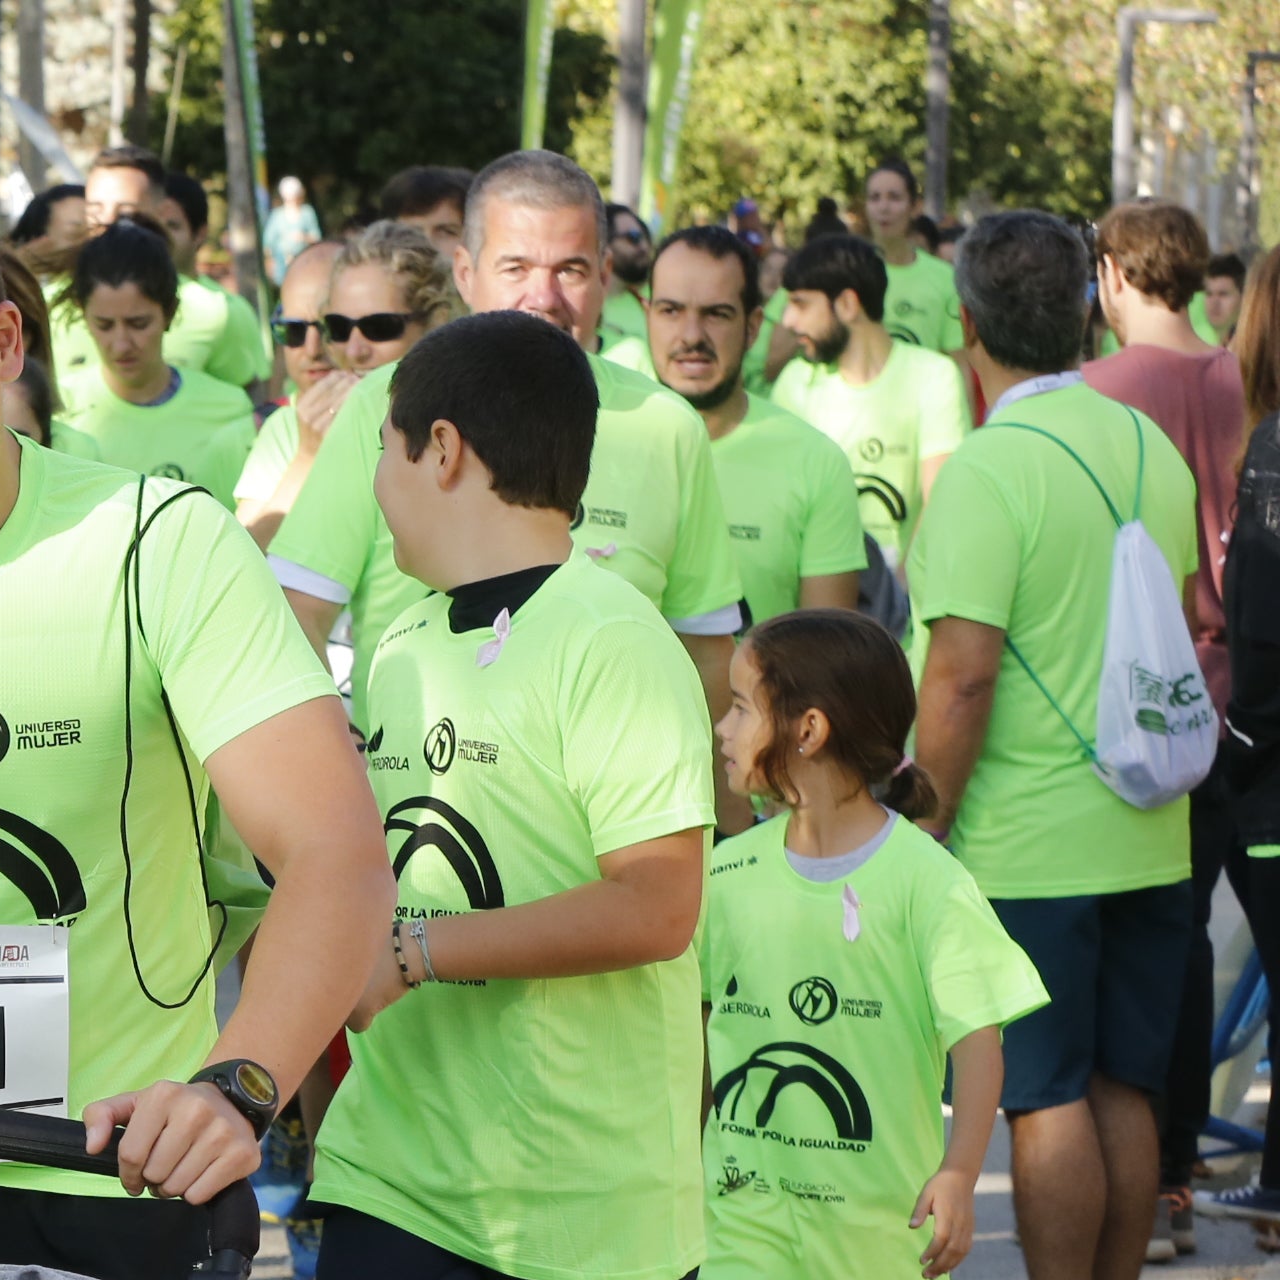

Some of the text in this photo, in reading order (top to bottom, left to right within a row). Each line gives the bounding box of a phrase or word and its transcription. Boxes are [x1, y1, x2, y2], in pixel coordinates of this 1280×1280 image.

[589, 515, 627, 528] MUJER
[15, 719, 81, 735] UNIVERSO
[16, 732, 82, 750] MUJER
[457, 738, 499, 752] UNIVERSO
[457, 749, 498, 765] MUJER
[709, 858, 744, 876] uanvi
[410, 907, 427, 919] LA
[840, 998, 883, 1008] UNIVERSO
[840, 1006, 882, 1019] MUJER
[799, 1138, 866, 1153] IGUALDAD
